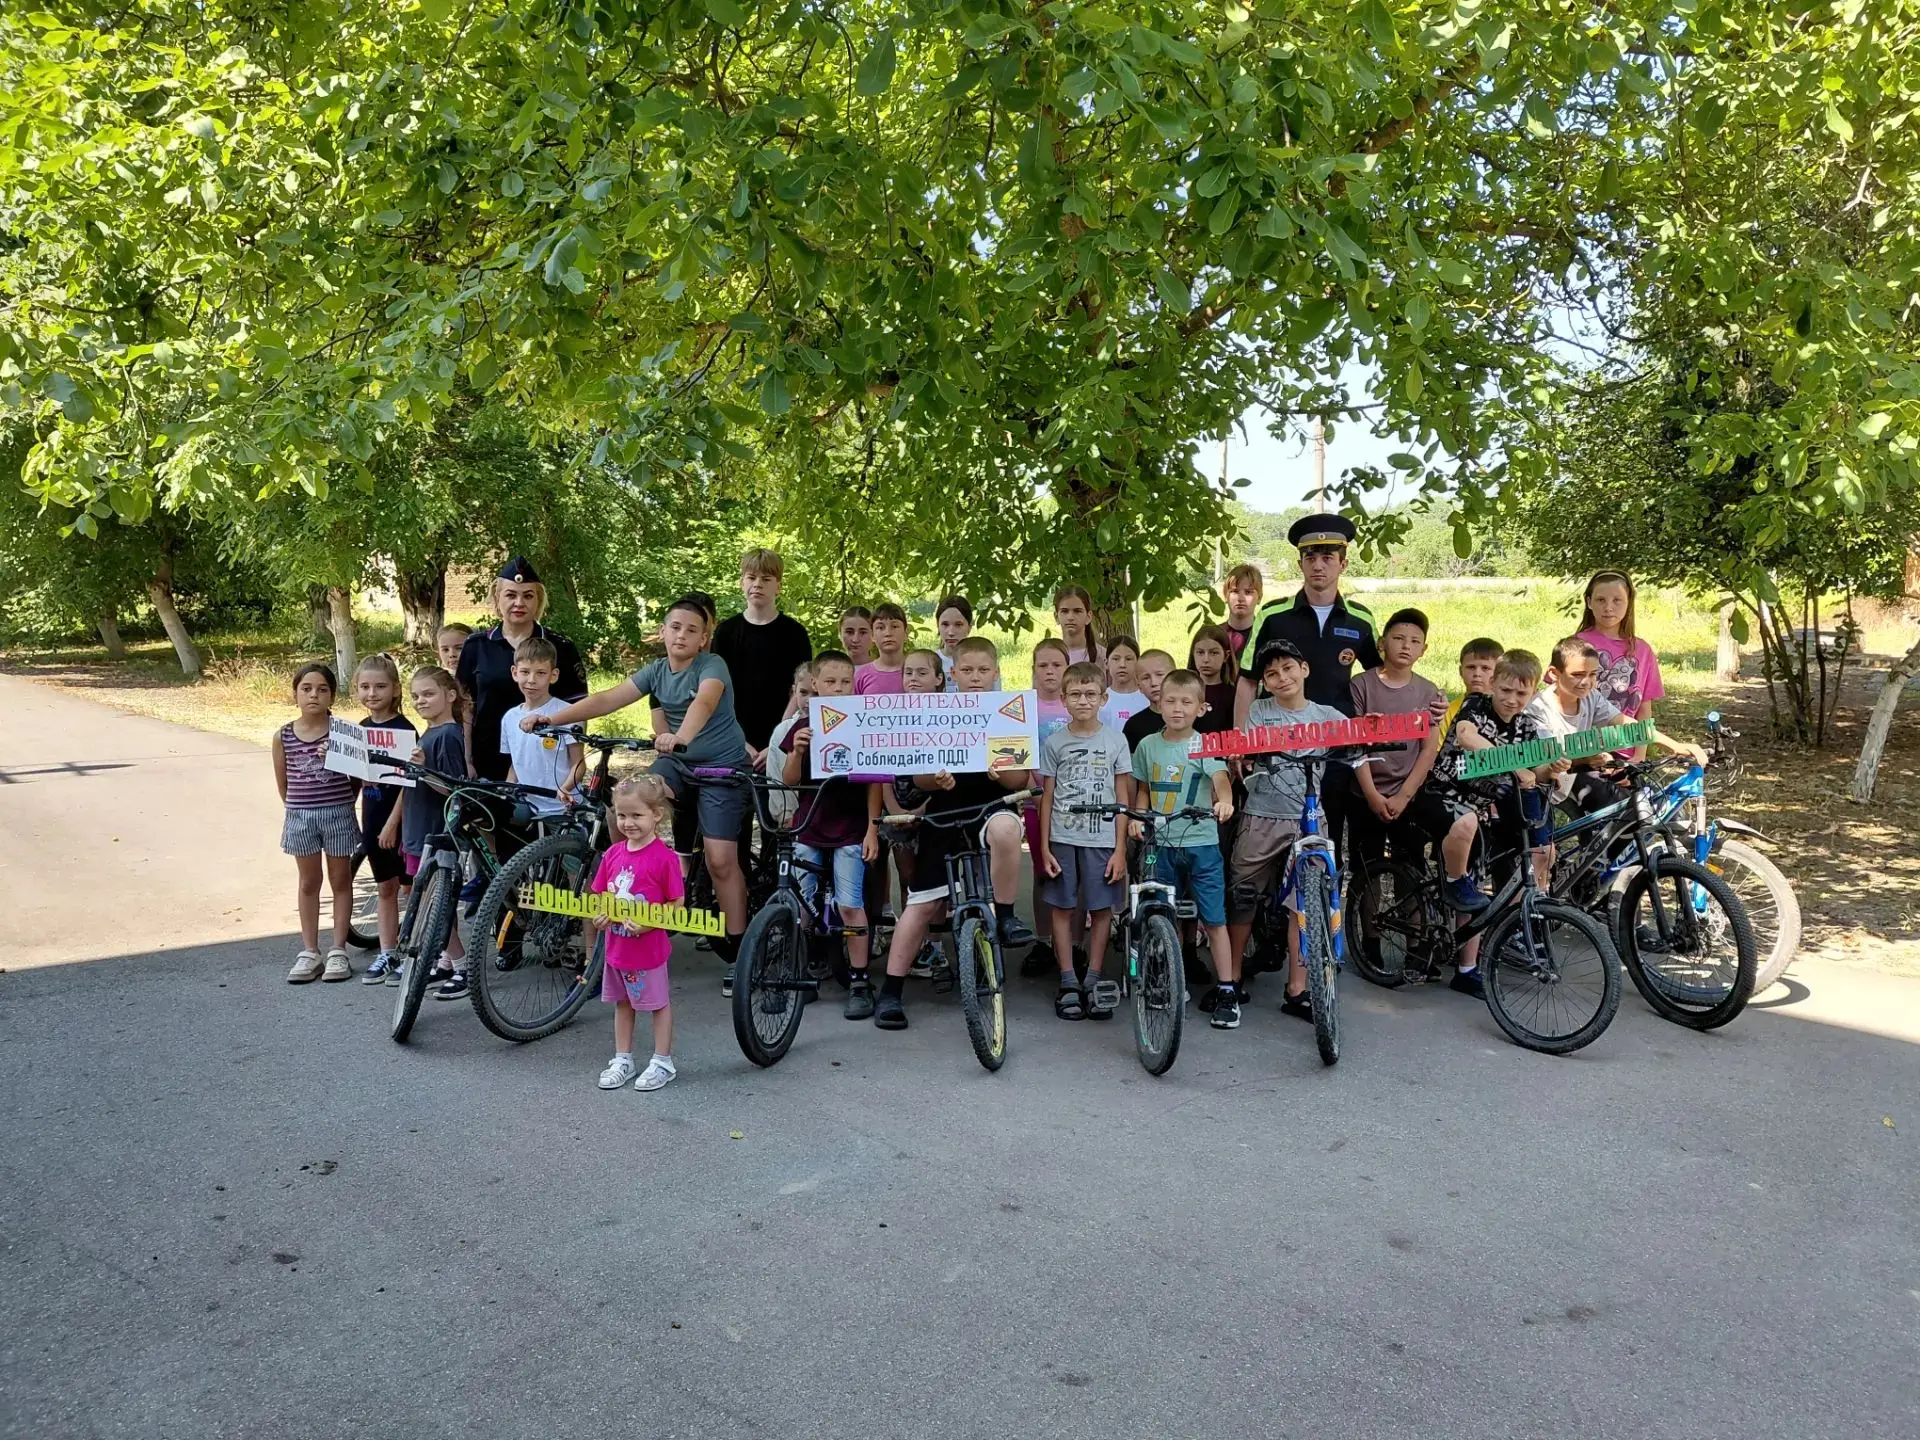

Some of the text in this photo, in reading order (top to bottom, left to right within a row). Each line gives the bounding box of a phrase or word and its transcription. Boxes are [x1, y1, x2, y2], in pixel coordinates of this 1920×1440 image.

[864, 694, 979, 710] ВОДИТЕЛЬ!
[855, 712, 992, 730] Уступи дорогу
[367, 729, 397, 749] ПДД,
[861, 732, 986, 748] ПЕШЕХОДУ!
[857, 749, 969, 767] Соблюдайте ПДД!
[518, 881, 726, 936] #ЮныеПешеходы
